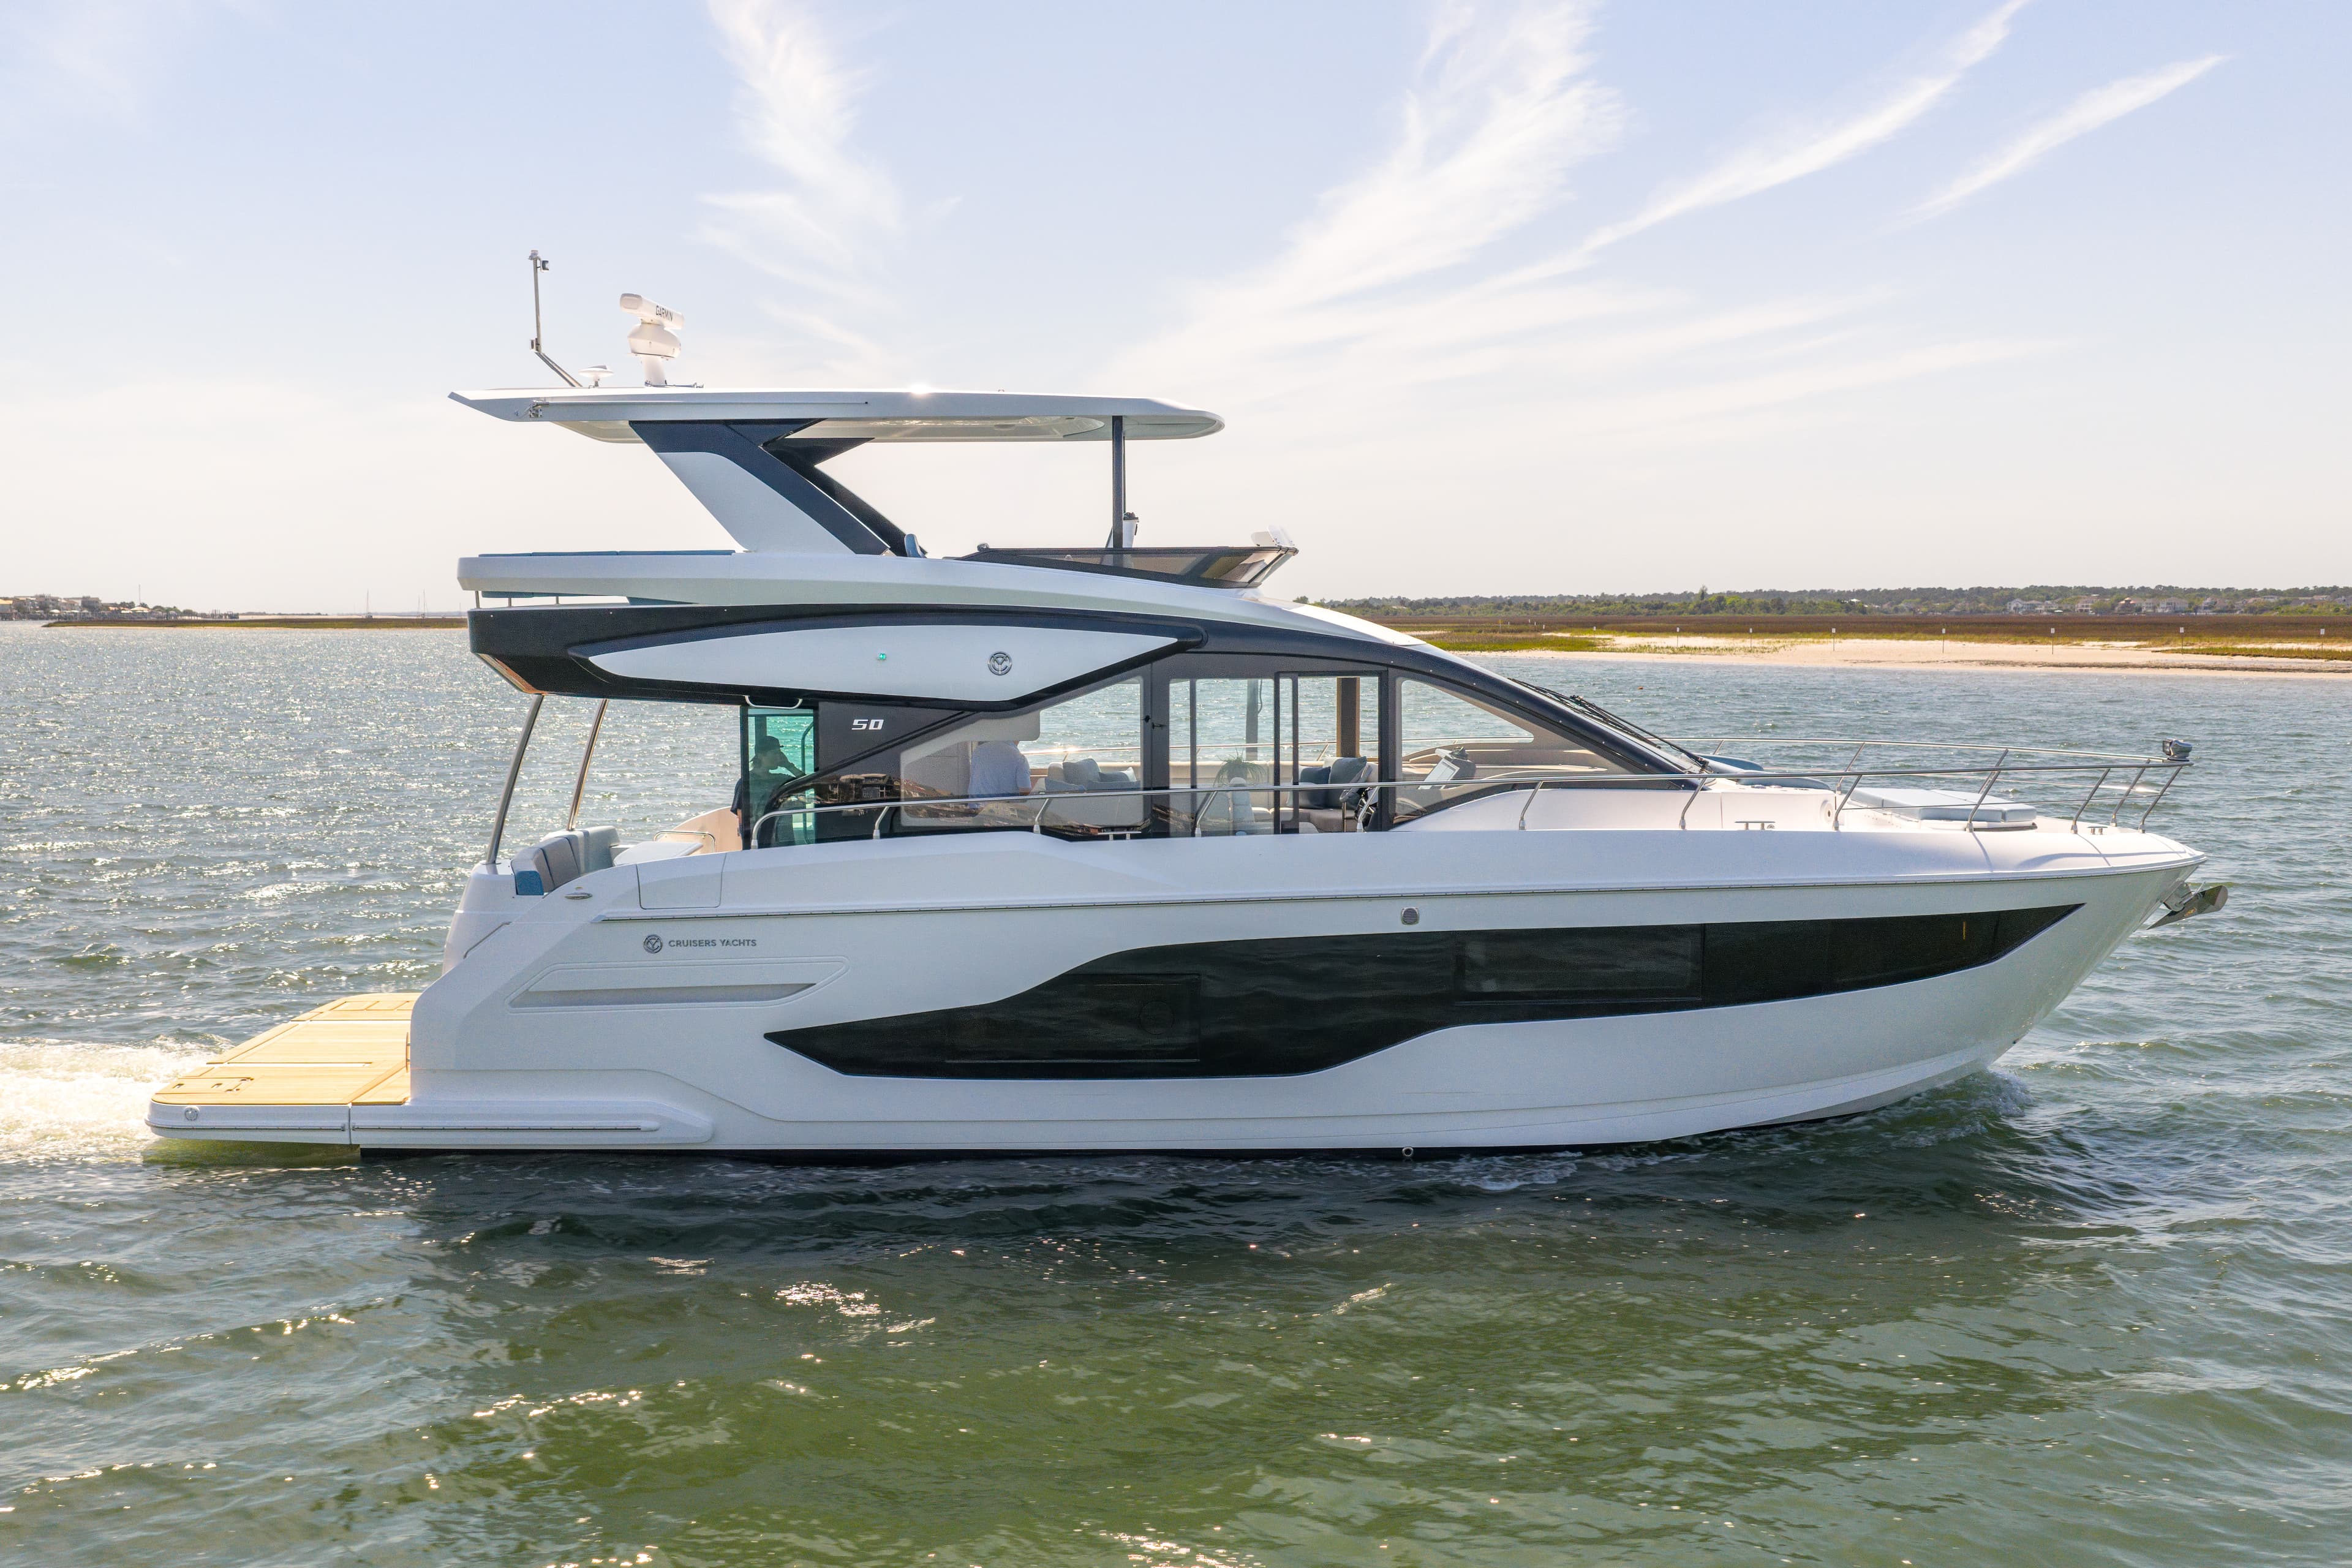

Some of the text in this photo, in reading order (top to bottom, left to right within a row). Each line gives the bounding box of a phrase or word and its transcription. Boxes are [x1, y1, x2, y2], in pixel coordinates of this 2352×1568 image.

[655, 305, 673, 322] GARMIN
[851, 719, 884, 730] 50
[668, 938, 757, 948] CRUISERS YACHTS
